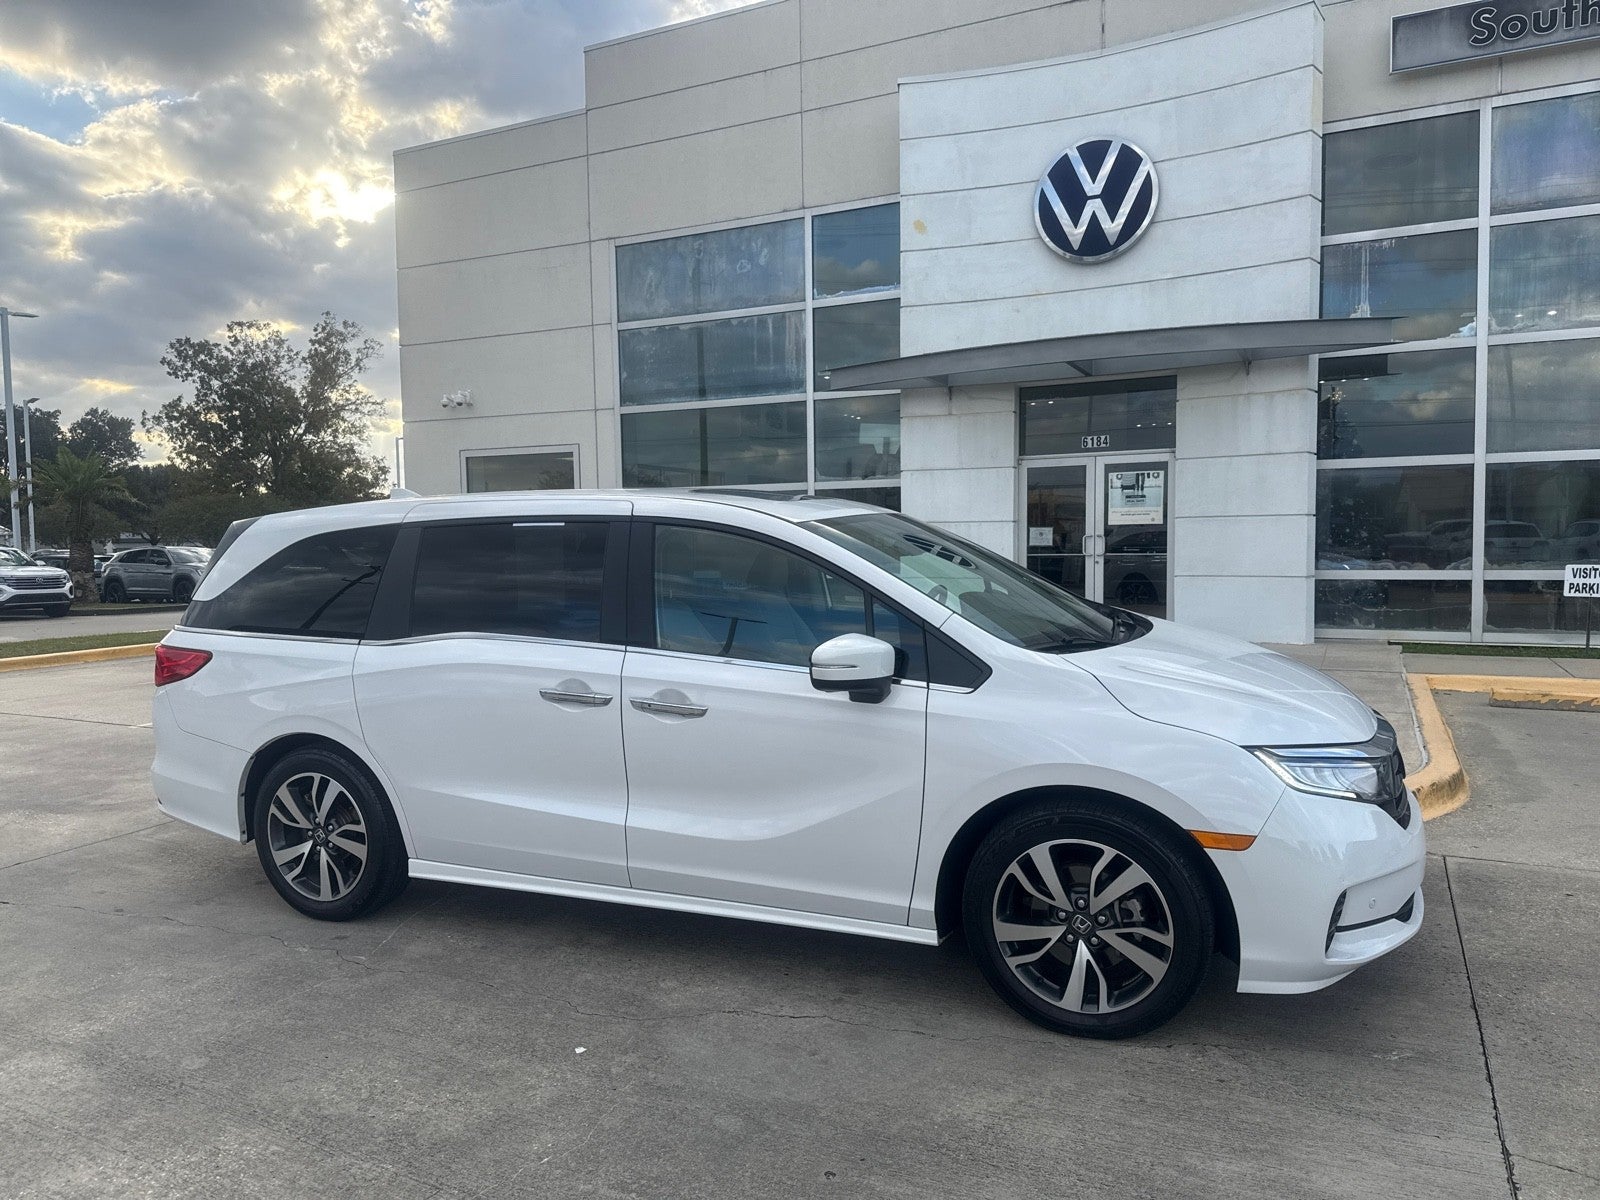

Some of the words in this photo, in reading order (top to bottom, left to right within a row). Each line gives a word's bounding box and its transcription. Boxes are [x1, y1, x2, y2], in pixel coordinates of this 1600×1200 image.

[1469, 0, 1600, 46] South
[1034, 136, 1158, 262] VW
[1082, 436, 1109, 448] 6184
[1571, 567, 1600, 579] VISIT
